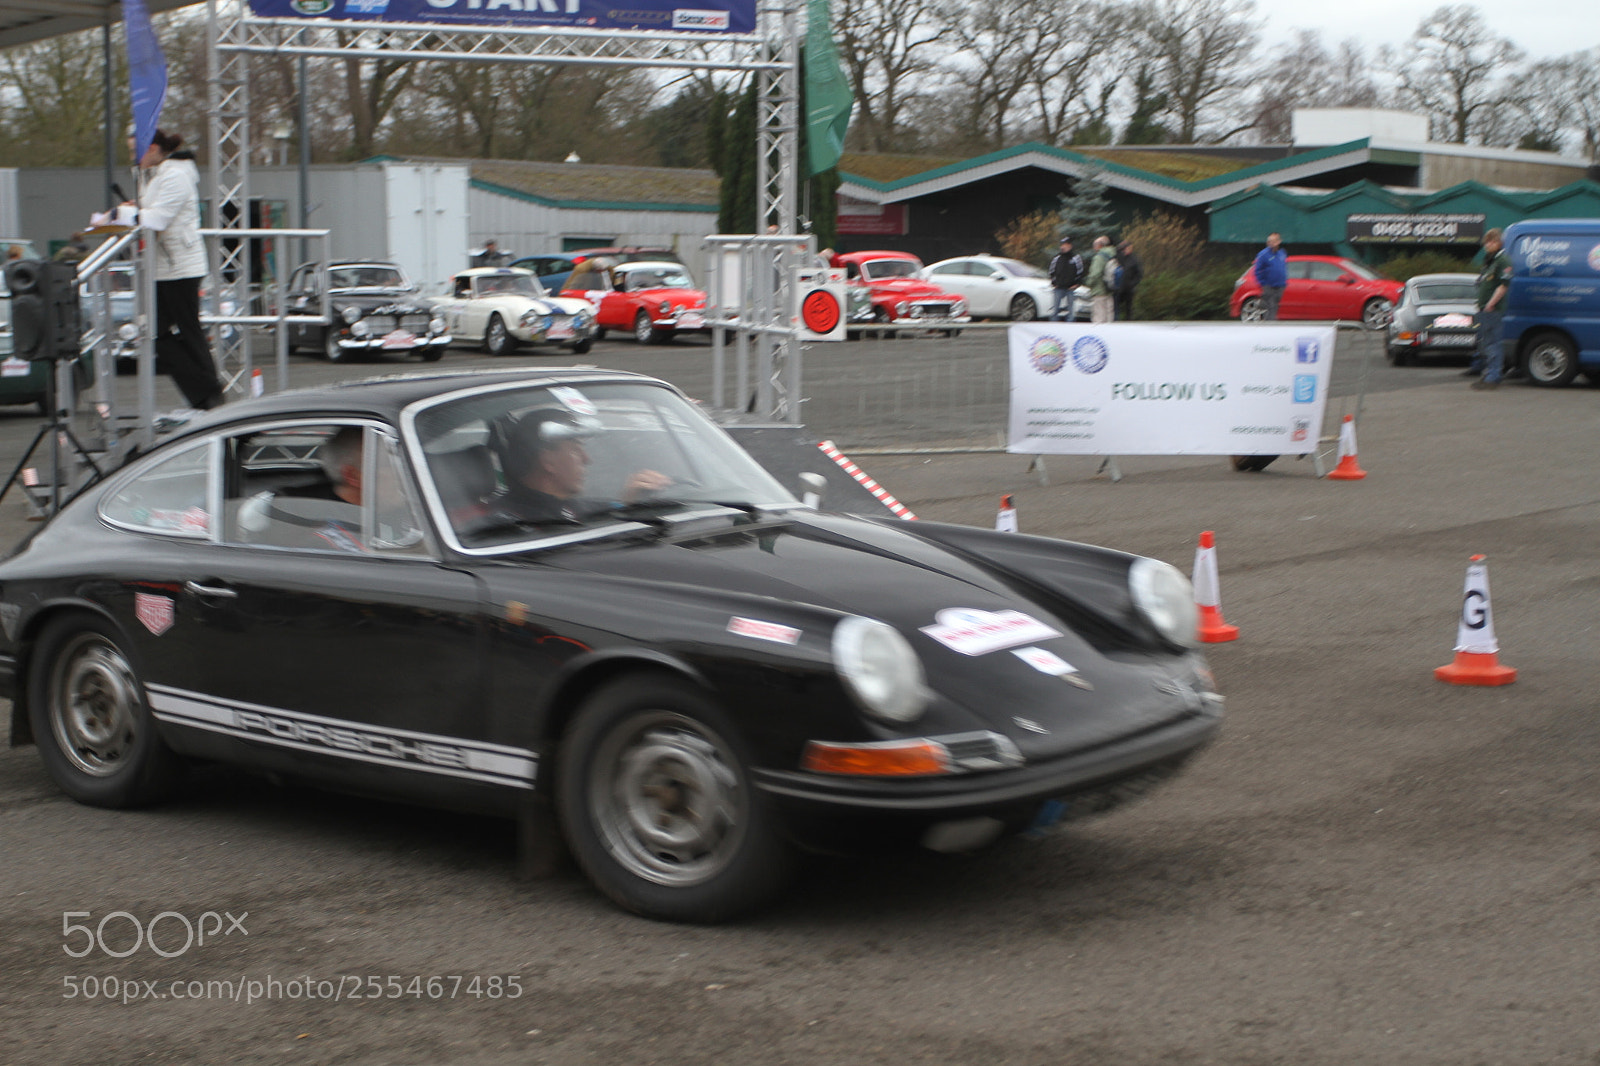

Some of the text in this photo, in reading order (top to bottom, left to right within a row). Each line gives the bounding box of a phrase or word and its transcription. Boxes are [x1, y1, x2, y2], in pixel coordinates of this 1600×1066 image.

[1112, 382, 1196, 401] FOLLOW
[1200, 382, 1227, 401] US
[1463, 589, 1487, 629] G
[232, 709, 466, 769] PORSCHE
